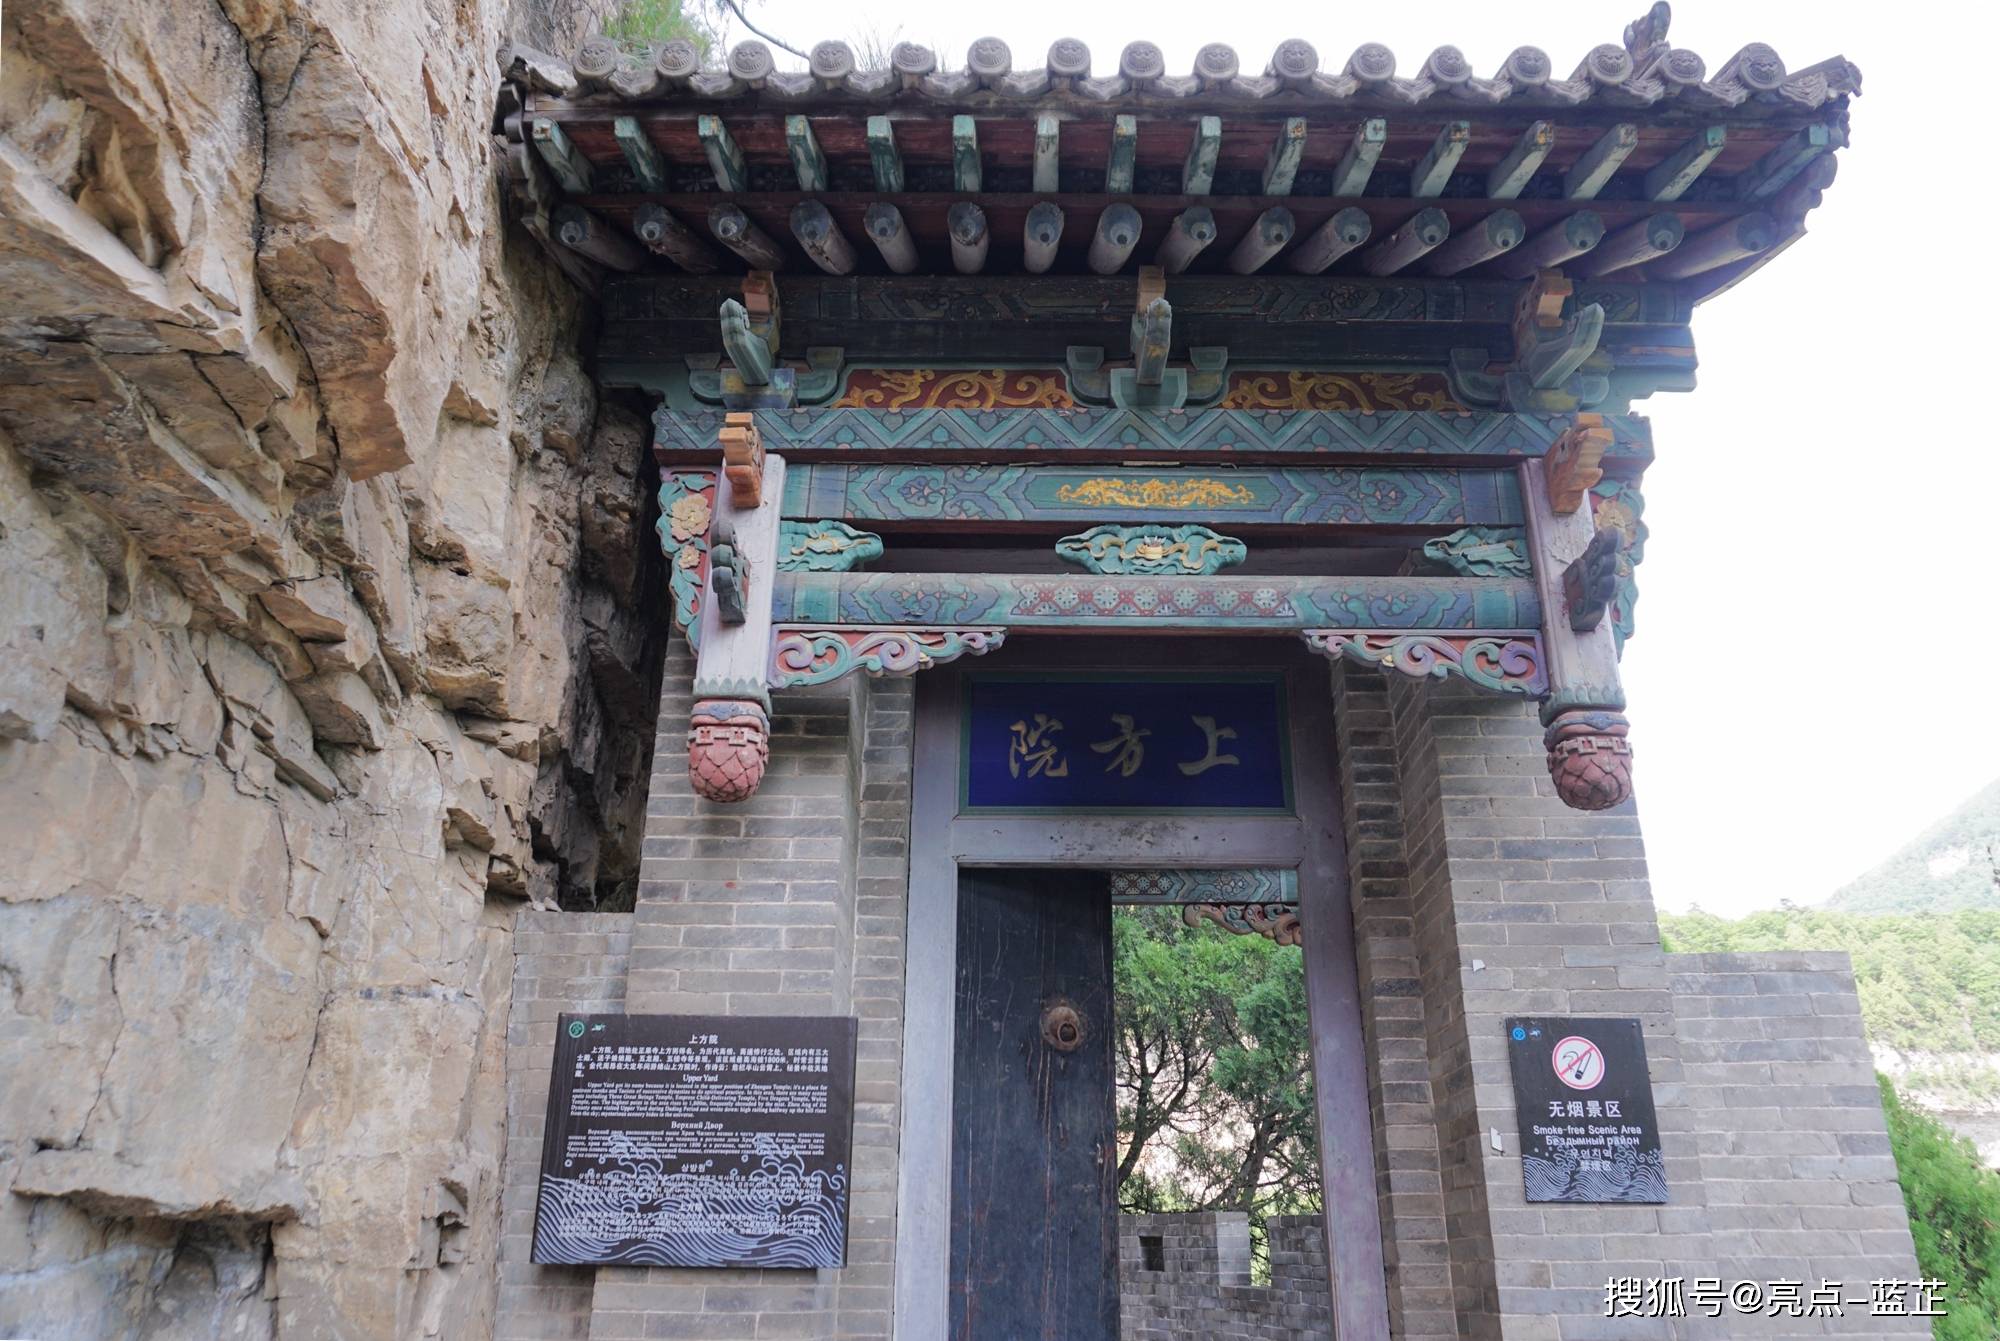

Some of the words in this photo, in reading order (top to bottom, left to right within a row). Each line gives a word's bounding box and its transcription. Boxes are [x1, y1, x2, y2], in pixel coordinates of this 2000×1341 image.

[1009, 712, 1240, 779] 上方院
[688, 1034, 718, 1044] 上方院
[683, 1074, 702, 1084] Upper
[704, 1074, 718, 1082] Yard
[1548, 1101, 1622, 1118] 无烟景区
[671, 1121, 702, 1130] Верхний
[704, 1121, 724, 1130] Двор
[1533, 1125, 1585, 1135] Smoke-free
[1588, 1125, 1617, 1135] Scenic
[1621, 1125, 1642, 1135] Area
[1546, 1136, 1605, 1146] Бездымный
[1607, 1136, 1639, 1147] район
